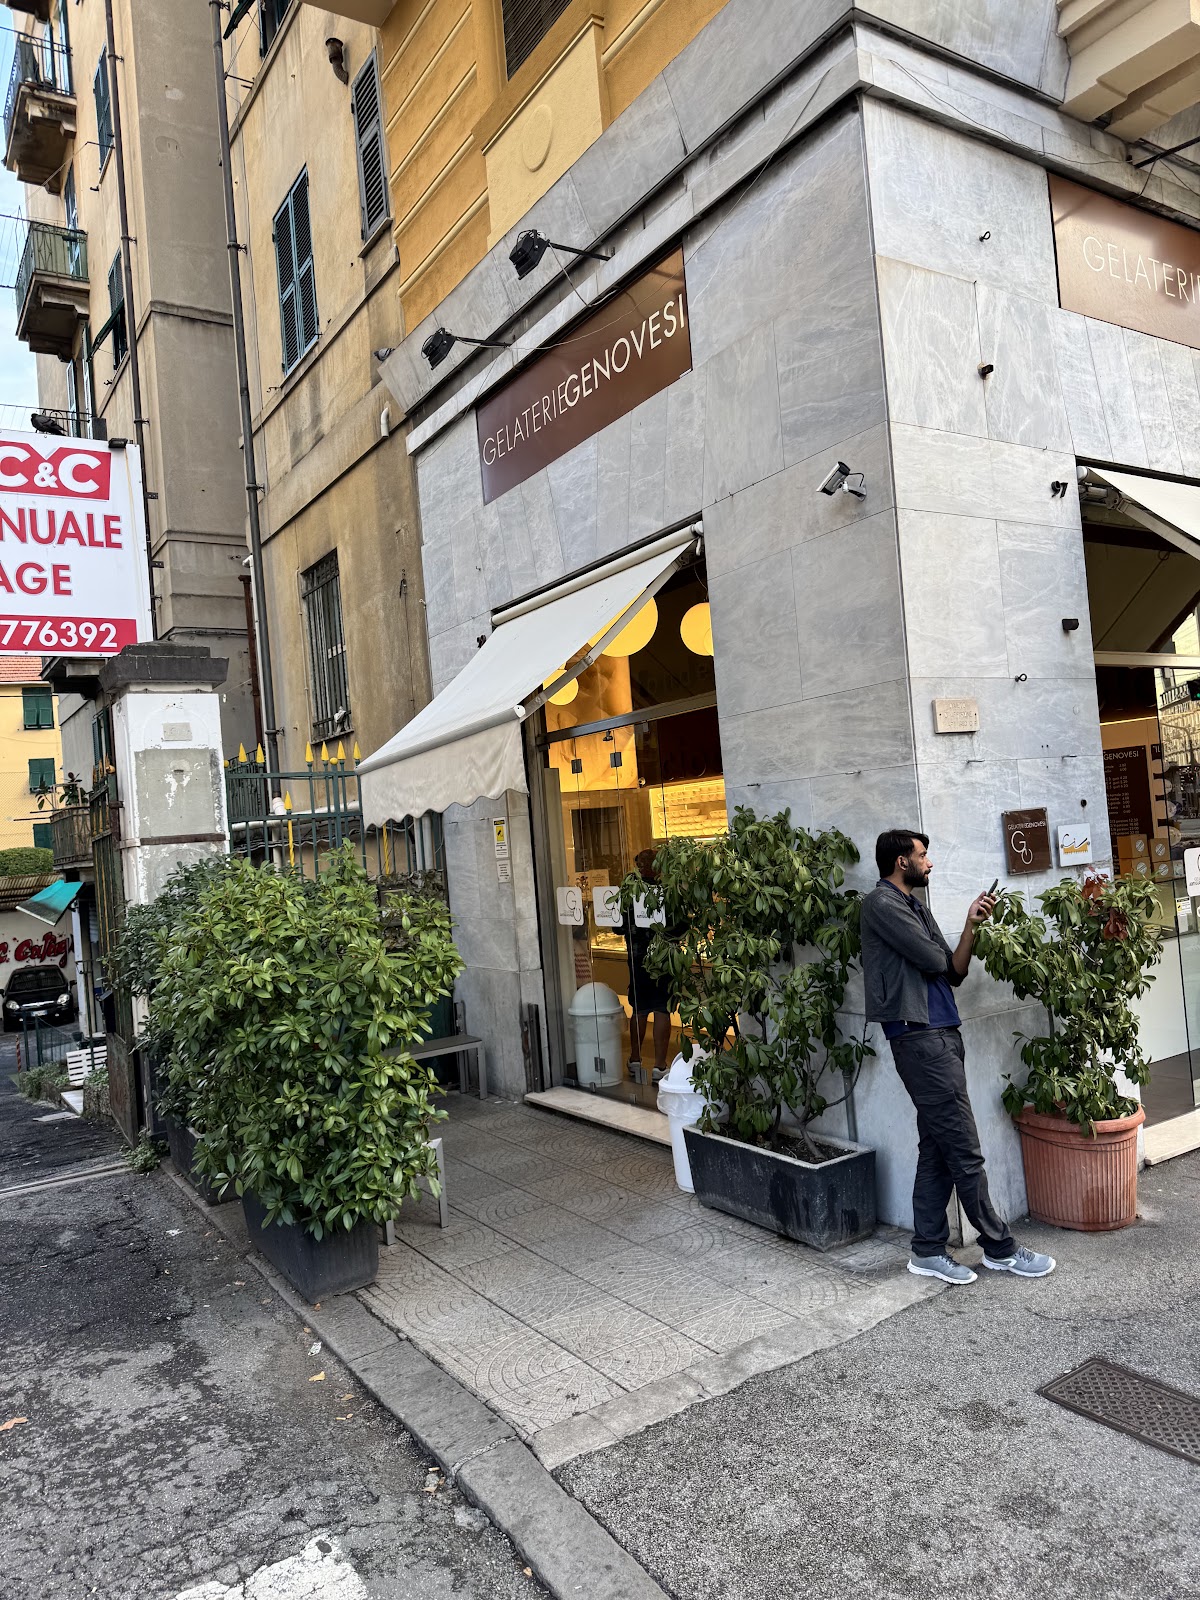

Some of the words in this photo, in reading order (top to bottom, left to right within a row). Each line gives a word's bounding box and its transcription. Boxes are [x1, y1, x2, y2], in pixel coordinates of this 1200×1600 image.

[0, 446, 102, 493] C&C
[1051, 480, 1069, 499] 97
[0, 620, 118, 648] 776392
